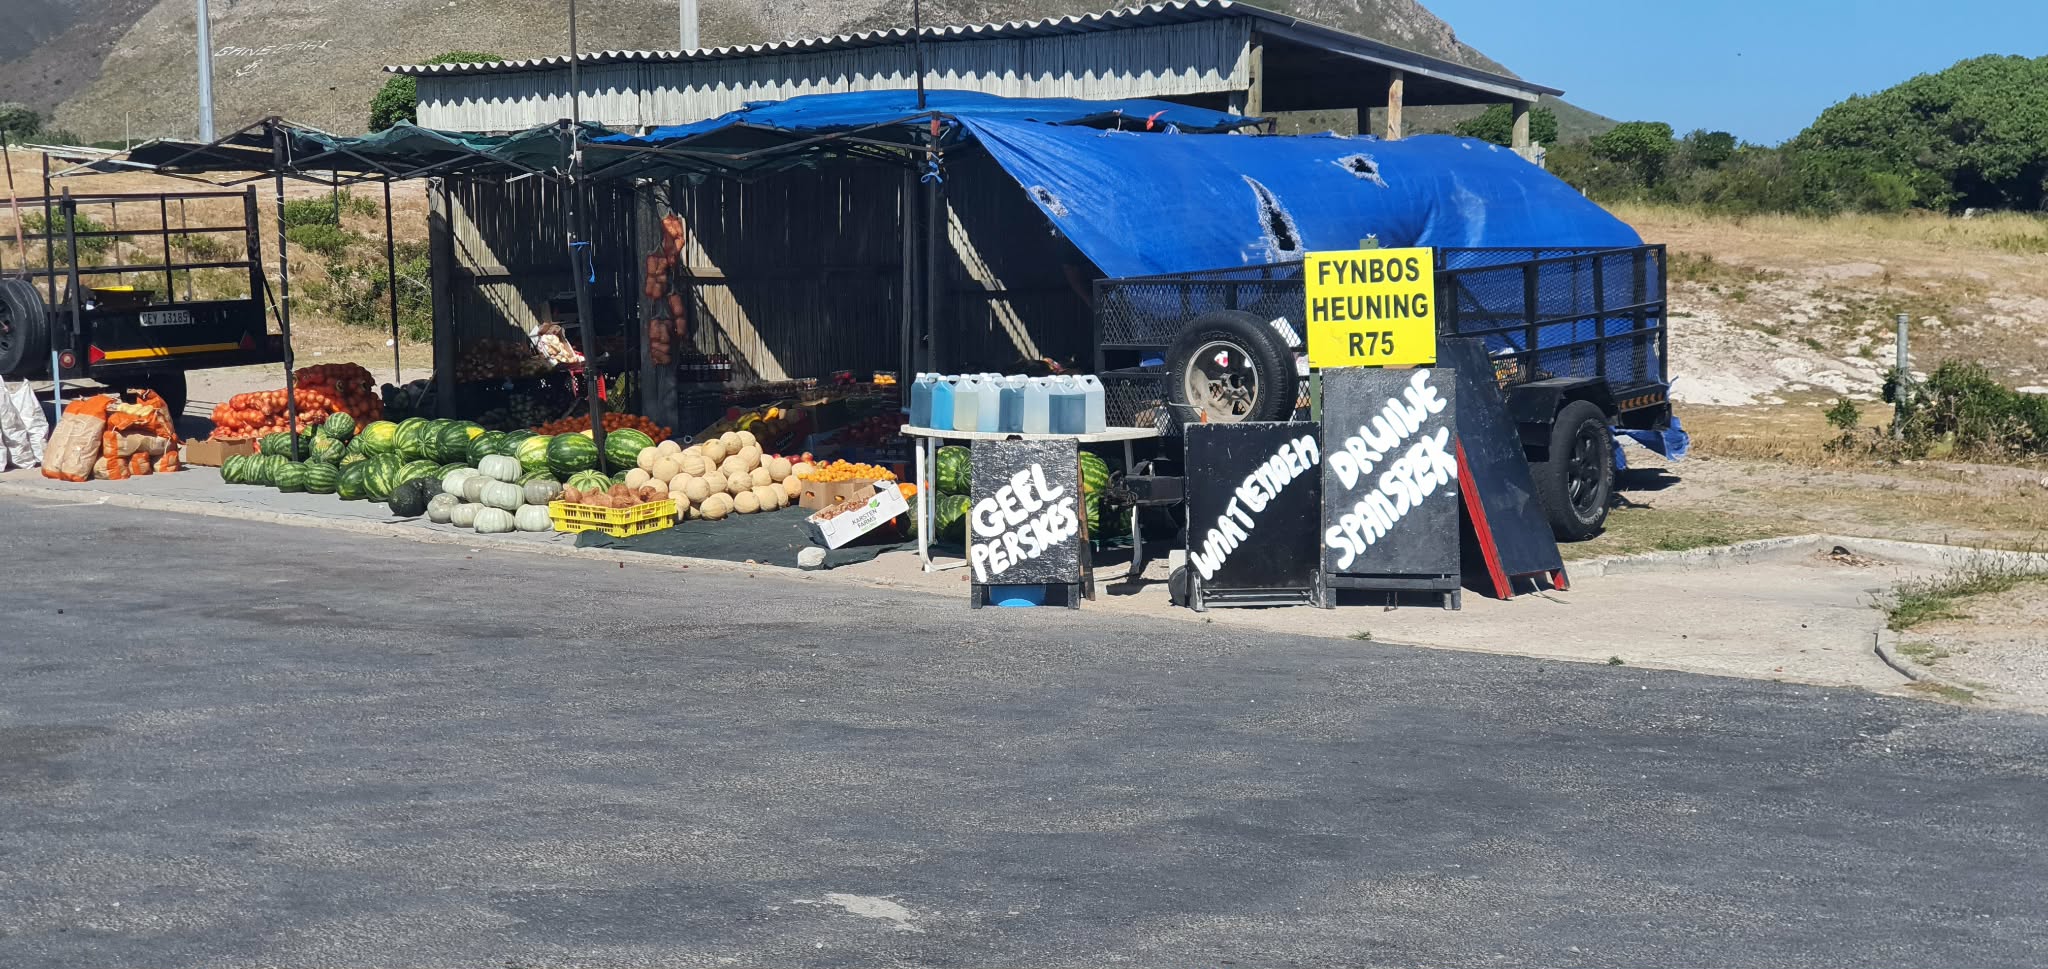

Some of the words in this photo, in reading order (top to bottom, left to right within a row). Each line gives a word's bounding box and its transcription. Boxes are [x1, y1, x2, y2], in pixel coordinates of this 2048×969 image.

[1318, 256, 1420, 285] FYNBOS
[1312, 293, 1429, 322] HEUNING
[1348, 331, 1395, 357] R75
[1328, 368, 1448, 491] DRUIWE
[971, 463, 1064, 537] GEEL
[1324, 426, 1458, 571] SPANSPEK
[852, 508, 878, 525] KARSTEN
[857, 516, 877, 529] FARMS
[970, 496, 1079, 582] PERSKES
